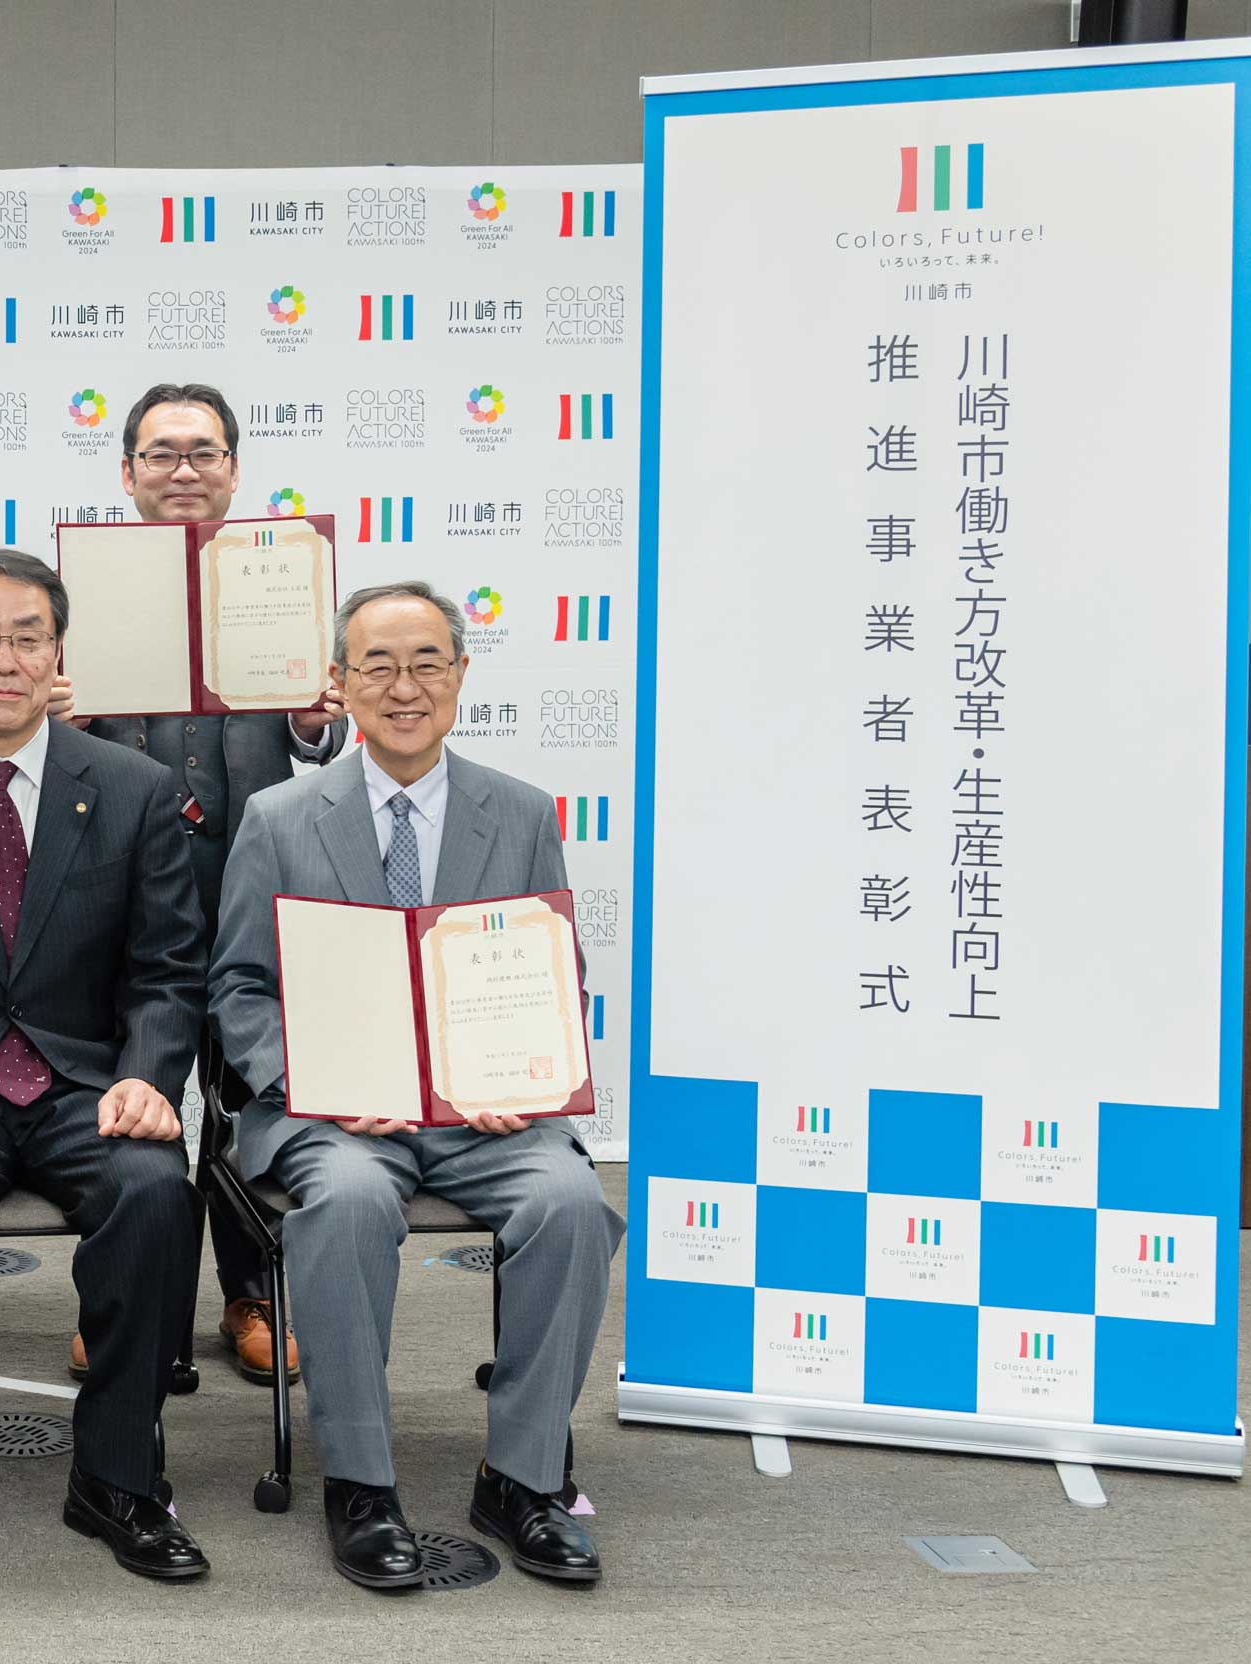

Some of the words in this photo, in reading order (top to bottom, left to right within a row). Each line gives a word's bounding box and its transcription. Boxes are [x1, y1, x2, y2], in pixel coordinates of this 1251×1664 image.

[250, 201, 324, 223] 川崎市
[347, 204, 426, 221] FUTURE!
[62, 229, 88, 238] Green
[90, 229, 102, 238] For
[104, 229, 115, 238] All
[250, 228, 298, 236] KAWASAKI
[302, 228, 324, 236] CITY
[348, 221, 426, 237] ACTIONS
[836, 230, 932, 249] Colors,
[941, 225, 1044, 244] Future!
[68, 238, 110, 246] KAWASAKI
[348, 238, 399, 247] KAWASAKI
[402, 238, 426, 247] 100th
[79, 247, 98, 255] 2024
[879, 253, 999, 268] いろいろって、未来。
[904, 282, 972, 301] 川崎市
[51, 304, 126, 326] 川崎市
[449, 299, 524, 321] 川崎市
[50, 331, 100, 339] KAWASAKI
[103, 331, 126, 339] CITY
[448, 326, 498, 334] KAWASAKI
[501, 326, 524, 334] CITY
[249, 403, 324, 425] 川崎市
[346, 406, 425, 423] FUTURE!
[248, 430, 298, 438] KAWASAKI
[301, 430, 324, 438] CITY
[347, 423, 425, 439] ACTIONS
[347, 440, 398, 449] KAWASAKI
[400, 440, 425, 449] 100th
[448, 502, 522, 524] 川崎市
[448, 529, 496, 537] KAWASAKI
[500, 529, 522, 537] CITY
[859, 333, 920, 1014] 推進事業者表彰式
[948, 333, 1010, 1020] 川崎市働き方改革・生産性向上
[540, 706, 619, 723] FUTURE!
[495, 729, 518, 737] CITY
[541, 723, 619, 739] ACTIONS
[541, 740, 592, 749] KAWASAKI
[594, 740, 619, 749] 100th
